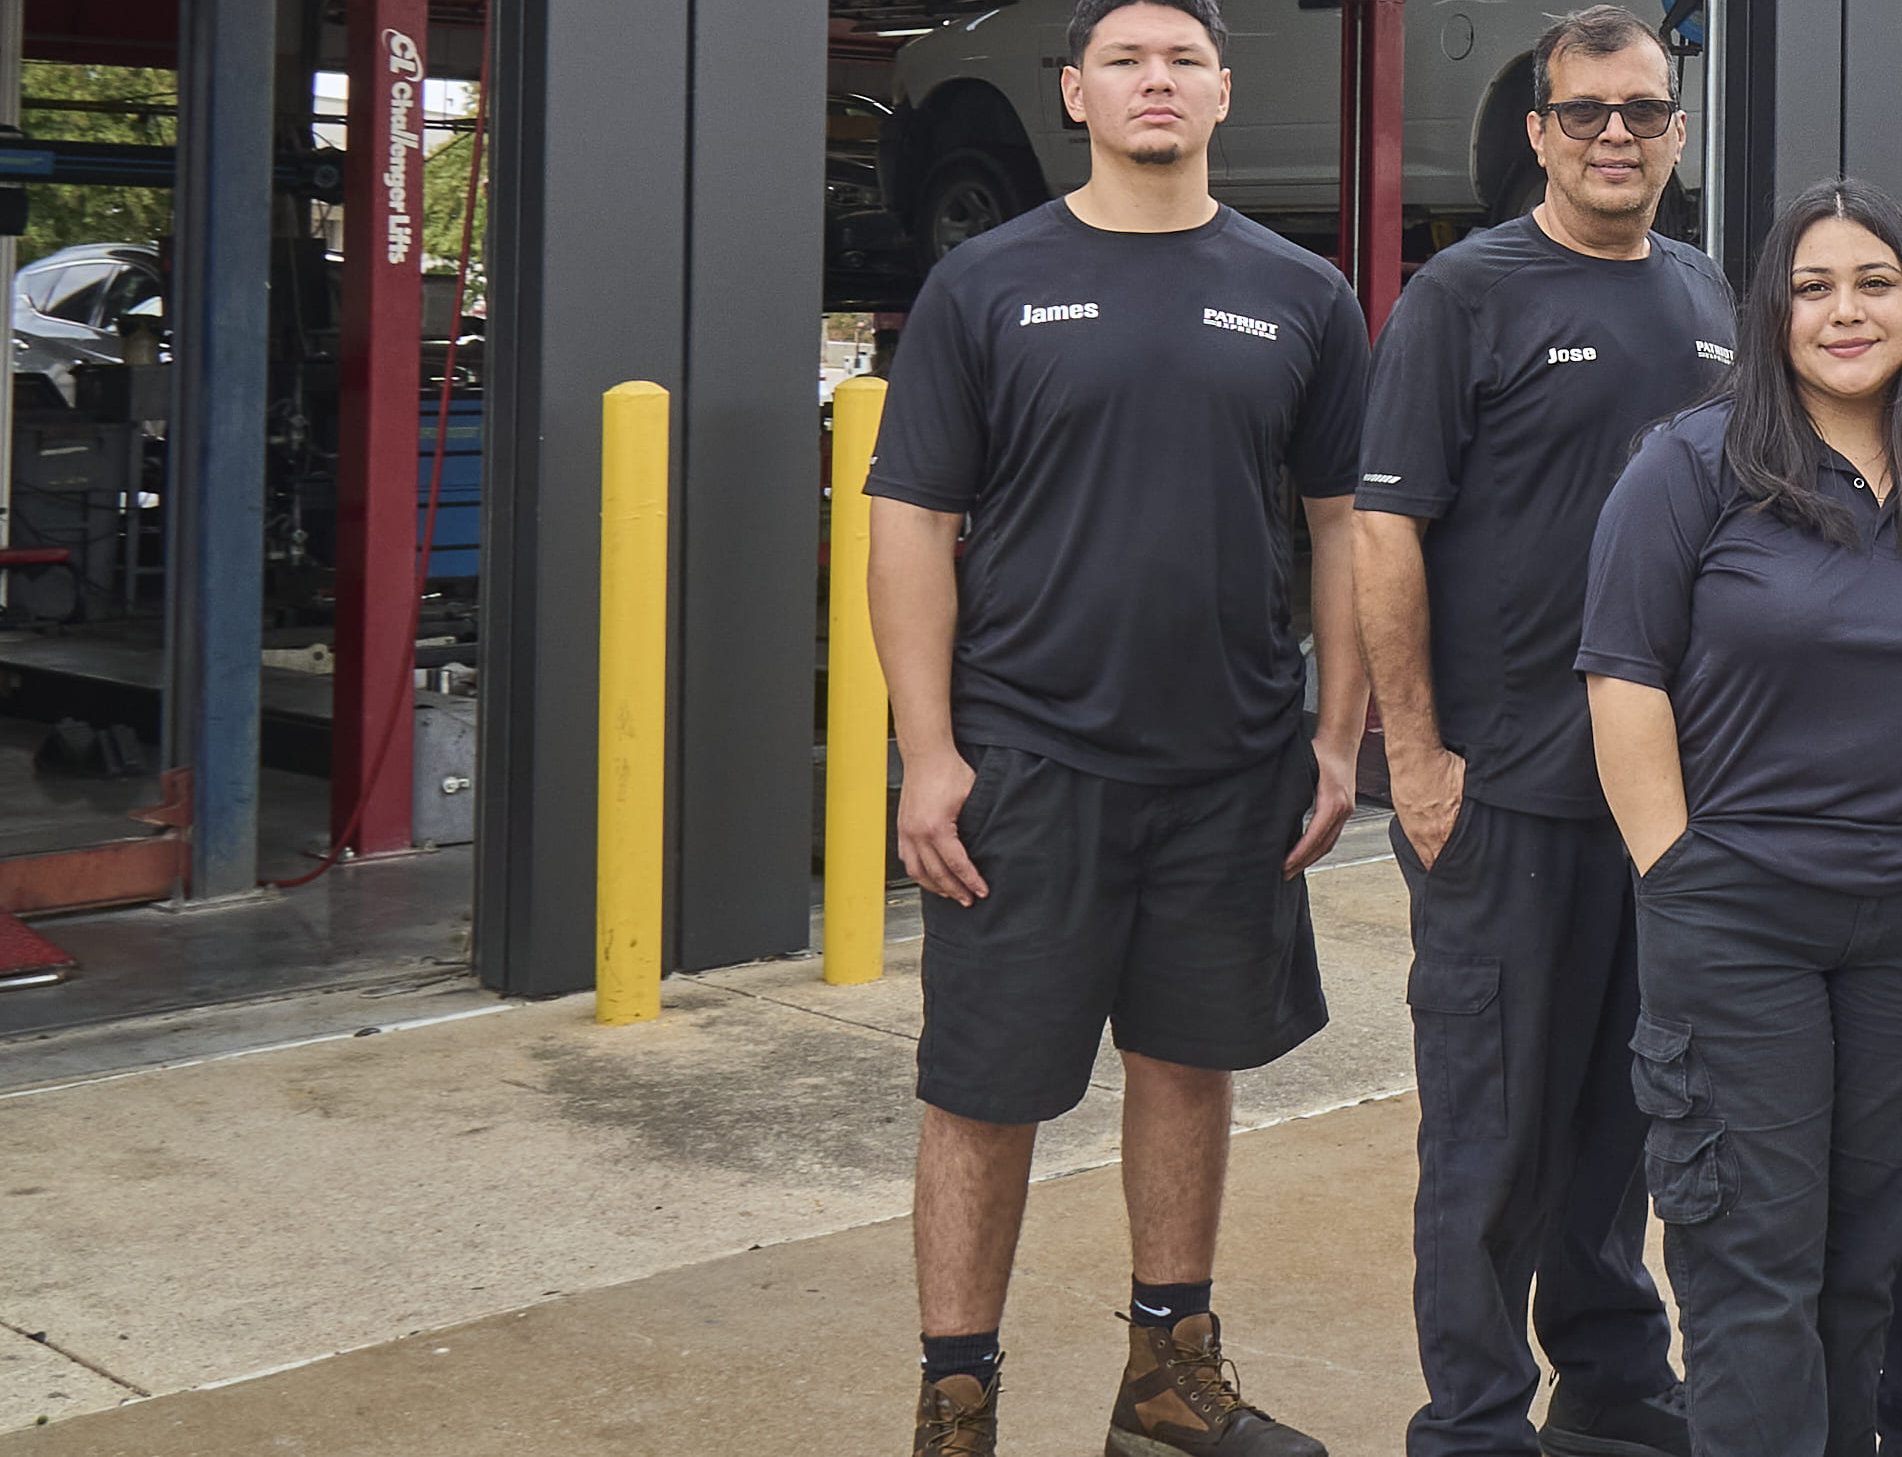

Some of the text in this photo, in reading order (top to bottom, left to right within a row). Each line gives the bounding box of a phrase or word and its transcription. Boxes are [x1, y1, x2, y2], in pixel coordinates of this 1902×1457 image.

[387, 214, 413, 265] Lifts
[1019, 302, 1100, 327] James
[1203, 307, 1279, 335] PATRIOT
[1547, 346, 1597, 365] Jose
[1695, 340, 1734, 361] PATRIOT
